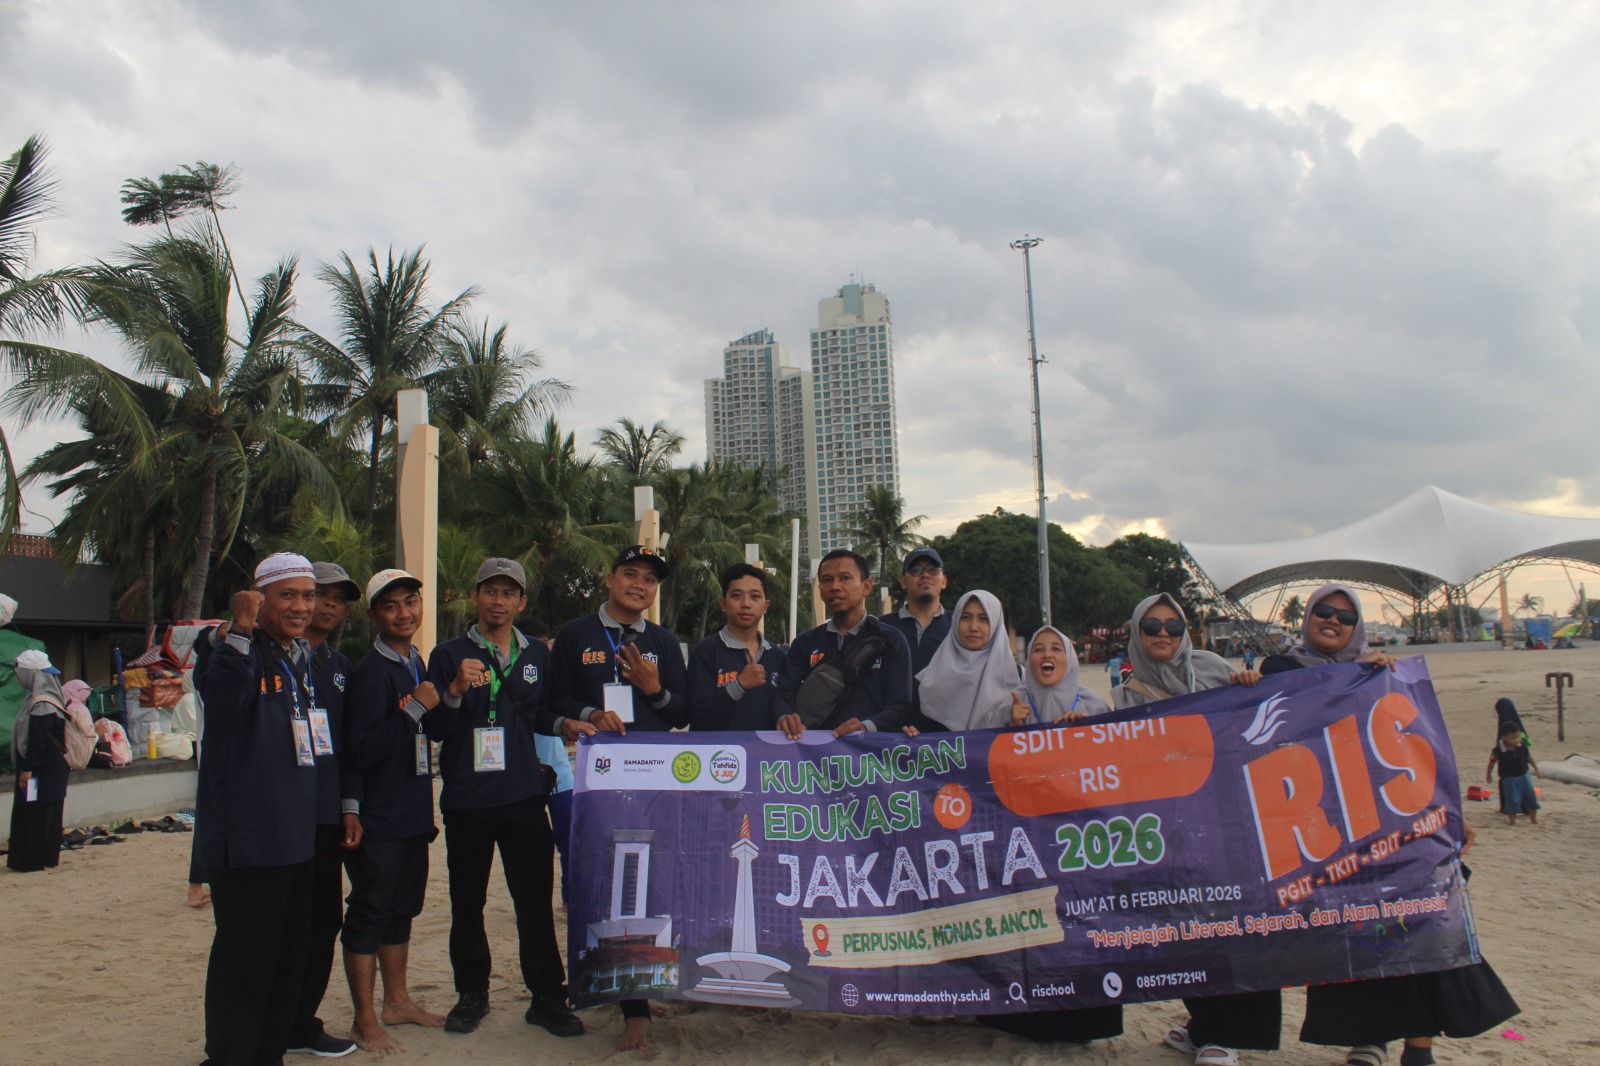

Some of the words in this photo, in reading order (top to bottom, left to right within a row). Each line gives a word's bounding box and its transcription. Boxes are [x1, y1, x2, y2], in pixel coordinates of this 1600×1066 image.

[582, 651, 606, 663] RIS
[1013, 728, 1066, 755] SDIT
[760, 736, 967, 793] KUNJUNGAN
[1079, 764, 1121, 793] RIS
[1242, 692, 1437, 882] RIS
[763, 790, 921, 841] EDUKASI
[939, 794, 966, 817] TO
[1055, 812, 1165, 872] 2026
[1276, 874, 1314, 908] PGIT
[1325, 852, 1359, 884] TKIT
[1370, 831, 1401, 861] SDIT
[1412, 805, 1447, 838] SMPIT
[775, 826, 1048, 908] JAKARTA
[1119, 894, 1129, 909] 6
[1131, 887, 1203, 908] FEBRUARI
[1205, 884, 1242, 901] 2026
[842, 928, 932, 953] PERPUSNAS,
[932, 918, 983, 948] MONAS
[984, 916, 999, 938] &
[1000, 907, 1049, 936] ANCOL
[1180, 915, 1243, 941] Literasi,
[1244, 910, 1309, 937] Sejarah,
[1310, 906, 1341, 927] dan
[1342, 902, 1379, 924] Alam
[865, 988, 991, 1005] www.ramadanthy.sch.id
[1031, 982, 1076, 998] rischool
[1136, 971, 1207, 989] 085171572141
